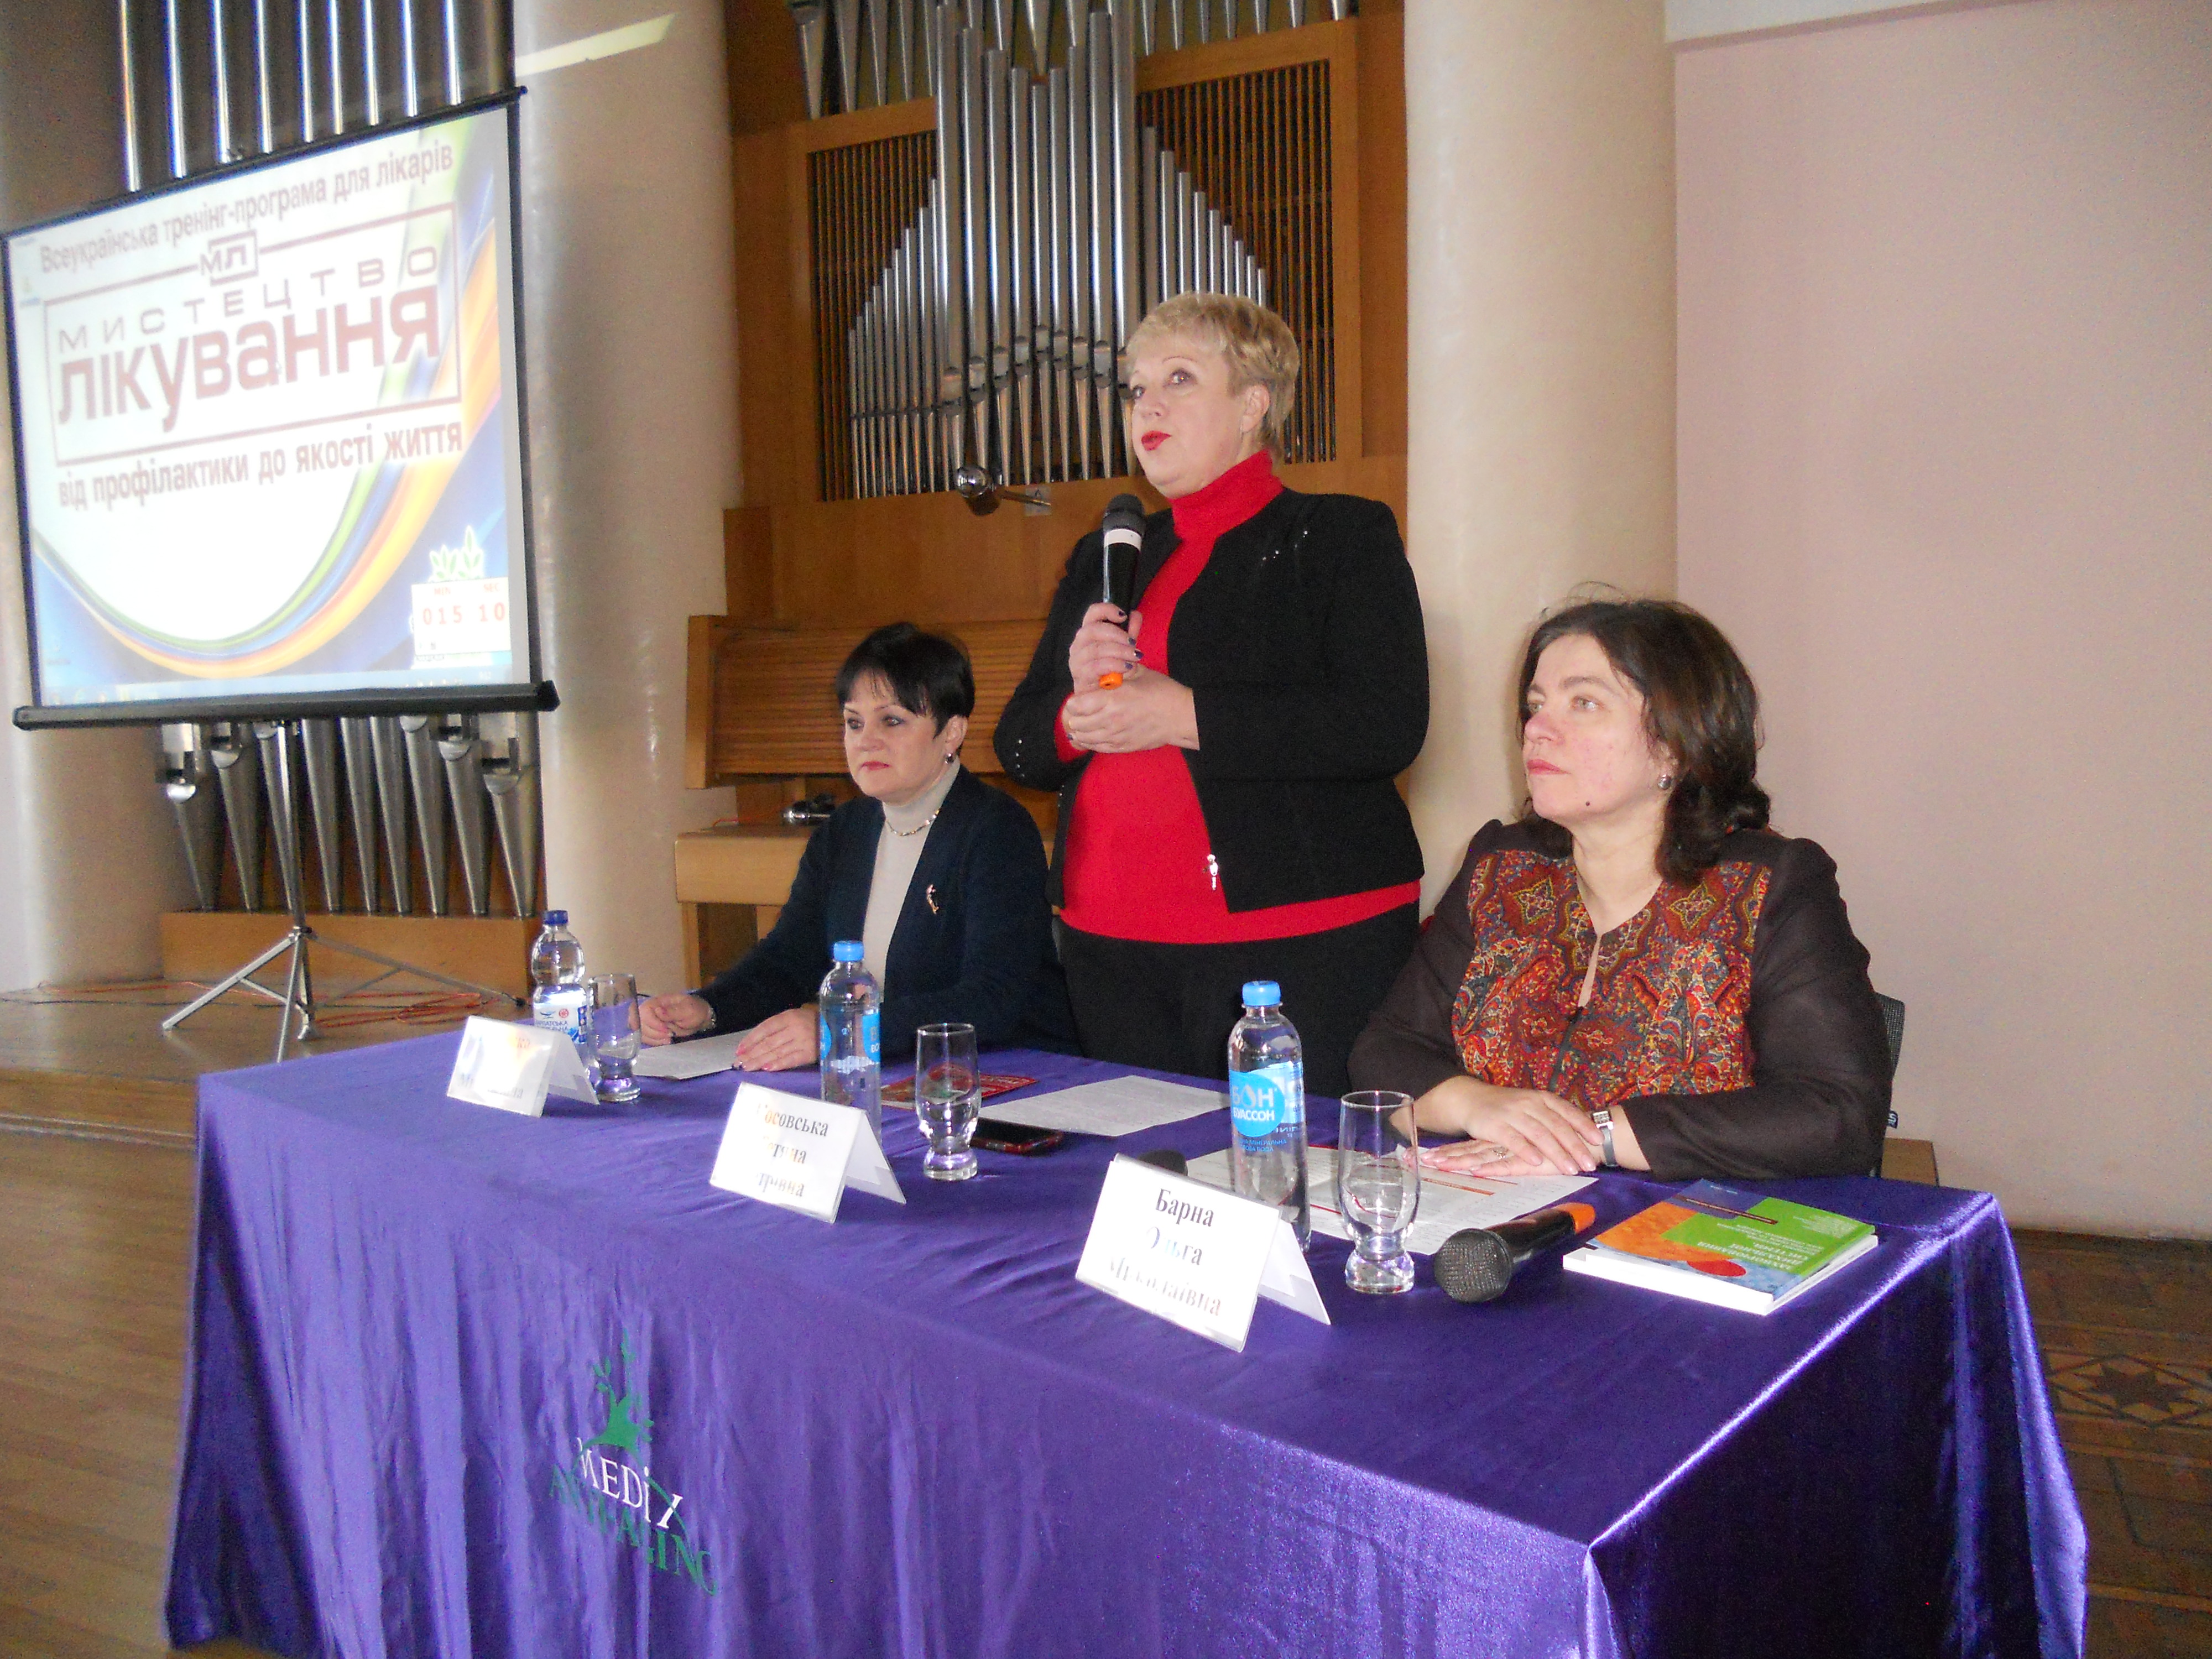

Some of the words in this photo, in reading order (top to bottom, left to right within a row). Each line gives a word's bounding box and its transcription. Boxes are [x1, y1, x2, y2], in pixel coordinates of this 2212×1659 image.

[163, 178, 327, 248] тренінг-програма
[335, 166, 370, 204] для
[377, 139, 453, 184] лікарів
[59, 246, 438, 353] МИСТЕЦТВО
[58, 471, 88, 512] від
[92, 454, 249, 512] профілактики
[258, 448, 286, 486] до
[479, 601, 506, 622] 10
[1233, 1107, 1275, 1121] БУАССОН
[1155, 1187, 1214, 1228] Барна
